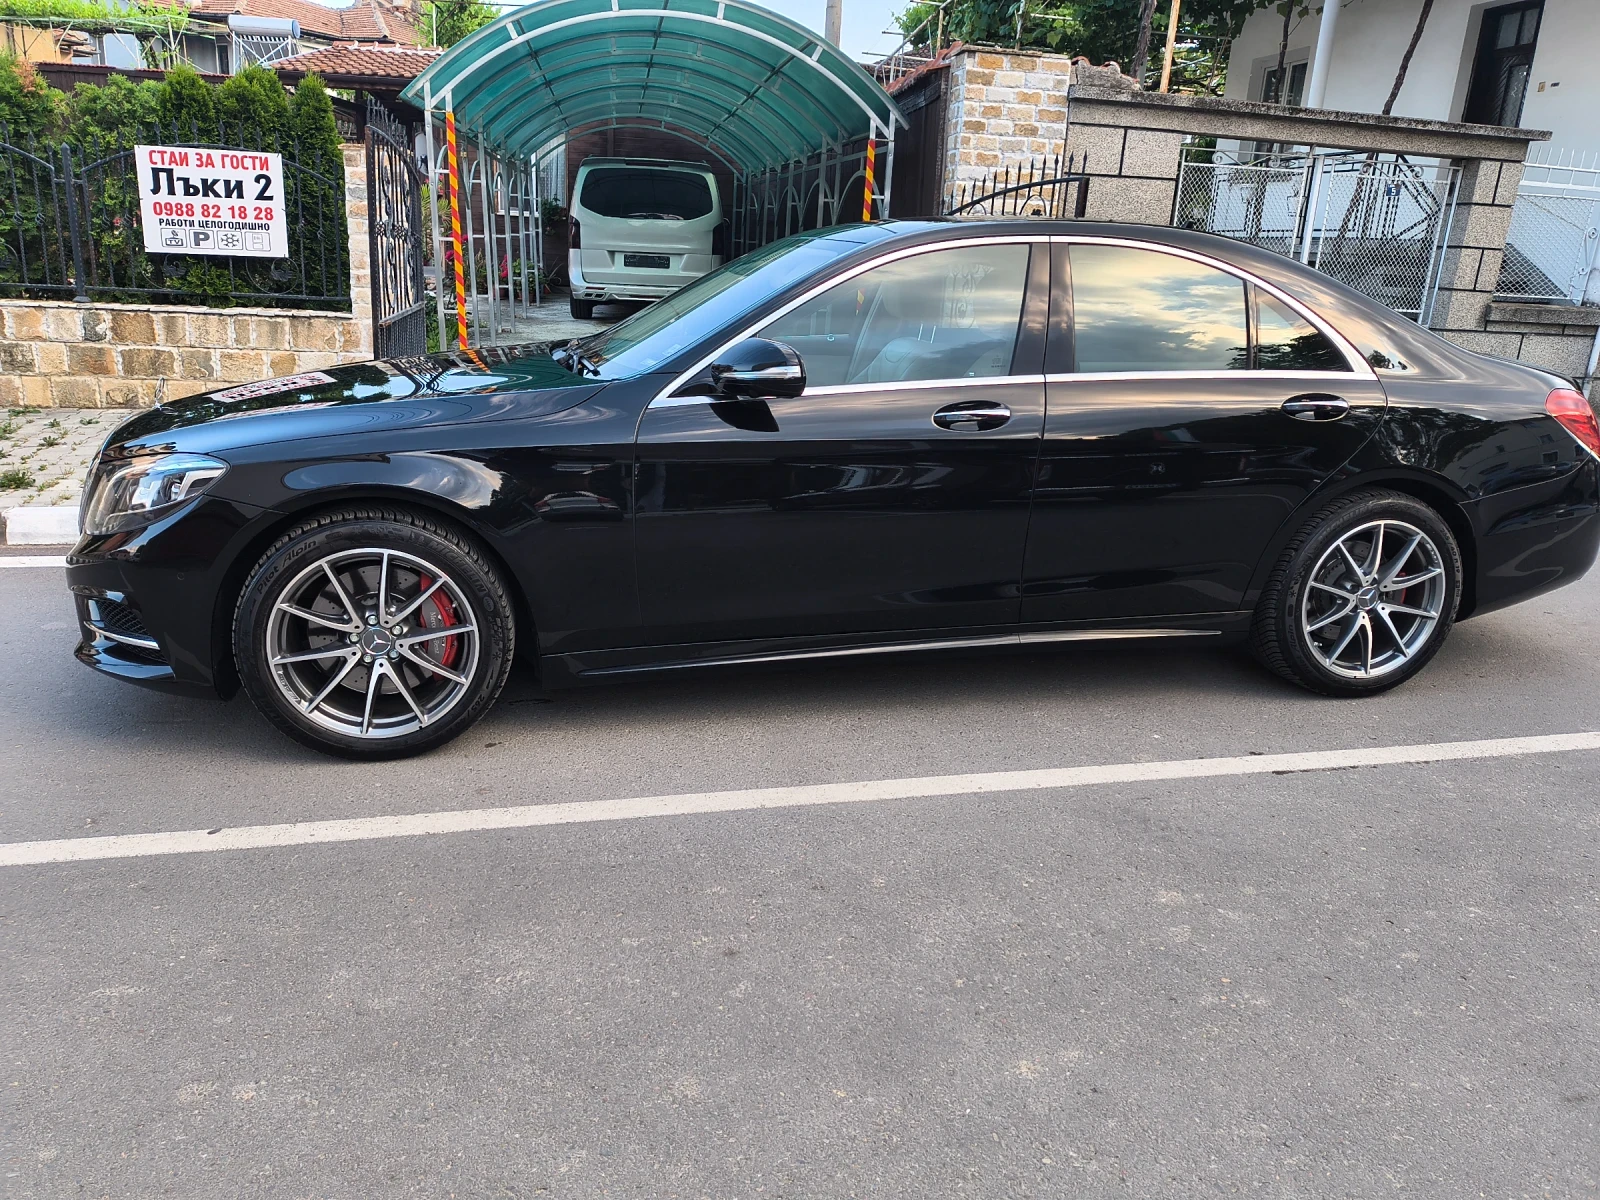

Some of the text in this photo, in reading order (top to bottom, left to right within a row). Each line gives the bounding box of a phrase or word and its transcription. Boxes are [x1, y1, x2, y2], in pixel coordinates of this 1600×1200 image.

[148, 150, 269, 171] СТАИ ЗА ГОСТИ
[149, 167, 274, 201] Лъки 2
[153, 201, 274, 221] 0988 82 18 28
[158, 218, 270, 231] РАБОТИ ЦЕЛОГОДИШНО
[193, 231, 210, 247] P
[257, 565, 280, 594] Pilot
[282, 540, 317, 568] Alpin
[427, 541, 489, 594] MICHELIN
